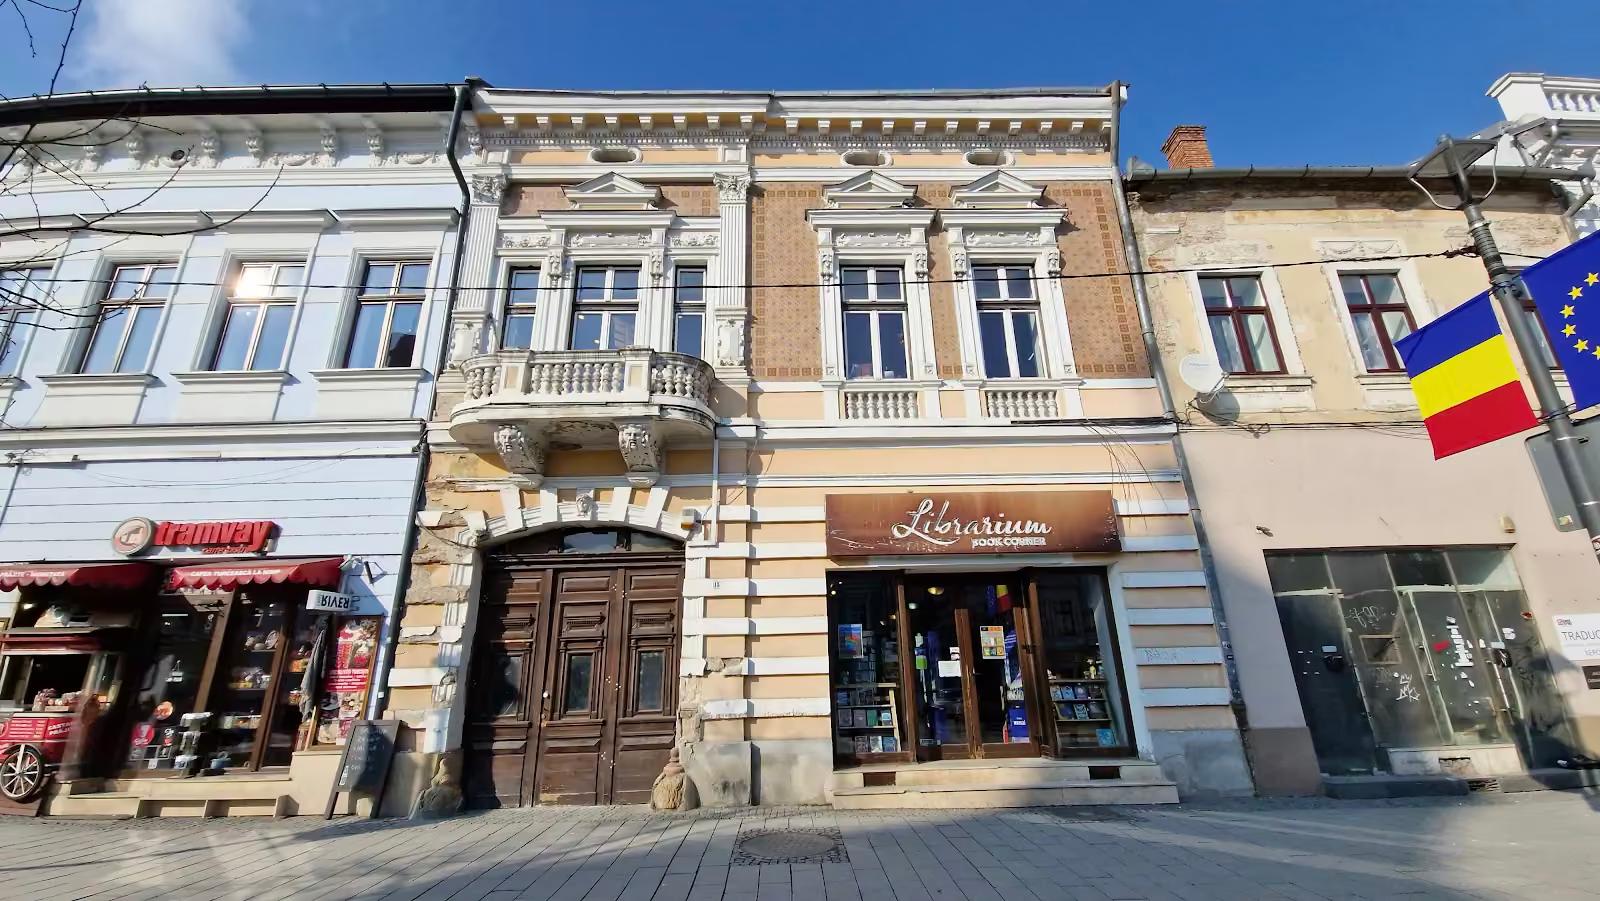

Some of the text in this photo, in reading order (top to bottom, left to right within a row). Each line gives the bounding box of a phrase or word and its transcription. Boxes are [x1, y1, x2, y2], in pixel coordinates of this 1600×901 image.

[157, 521, 273, 552] tramvay
[891, 498, 1053, 546] Librarium
[972, 536, 1047, 548] BOOK CORNER
